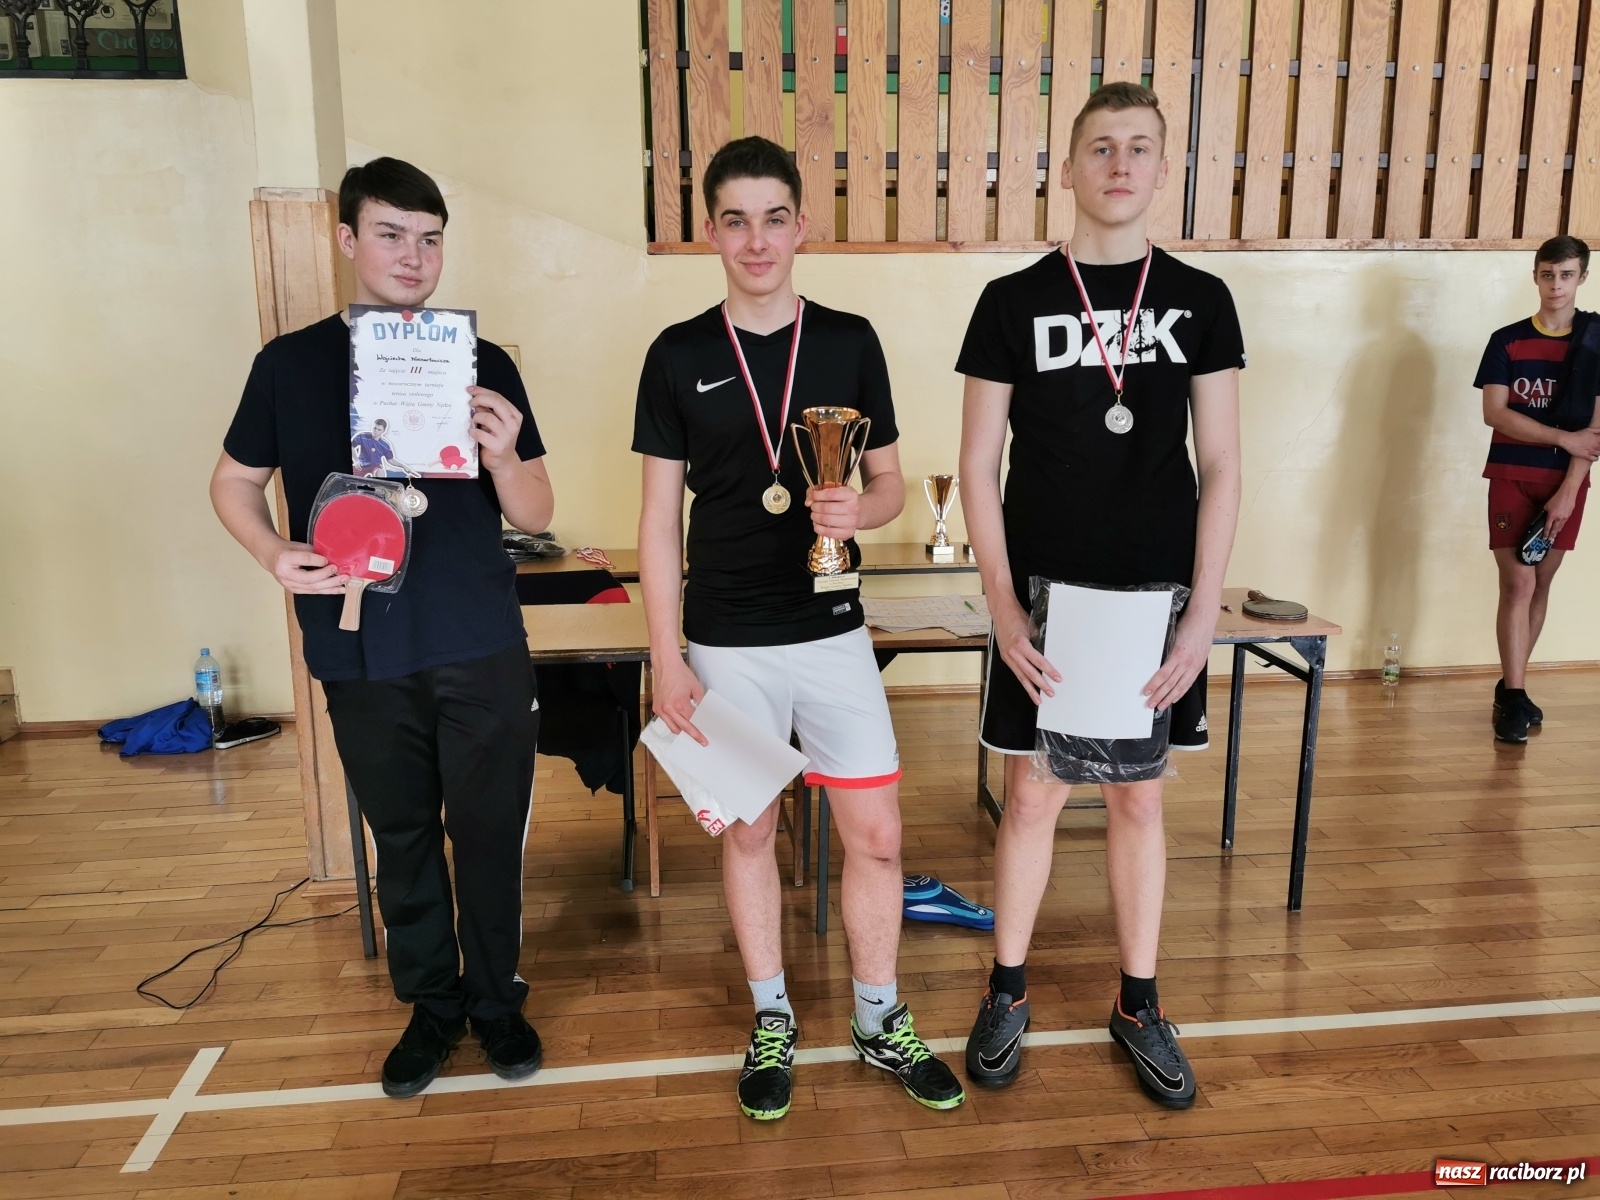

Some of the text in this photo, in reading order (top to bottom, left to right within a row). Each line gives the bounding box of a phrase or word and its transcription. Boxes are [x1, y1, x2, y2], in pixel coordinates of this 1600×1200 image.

[372, 322, 457, 344] DYPLOM
[410, 366, 423, 374] III
[1527, 397, 1552, 408] AIR
